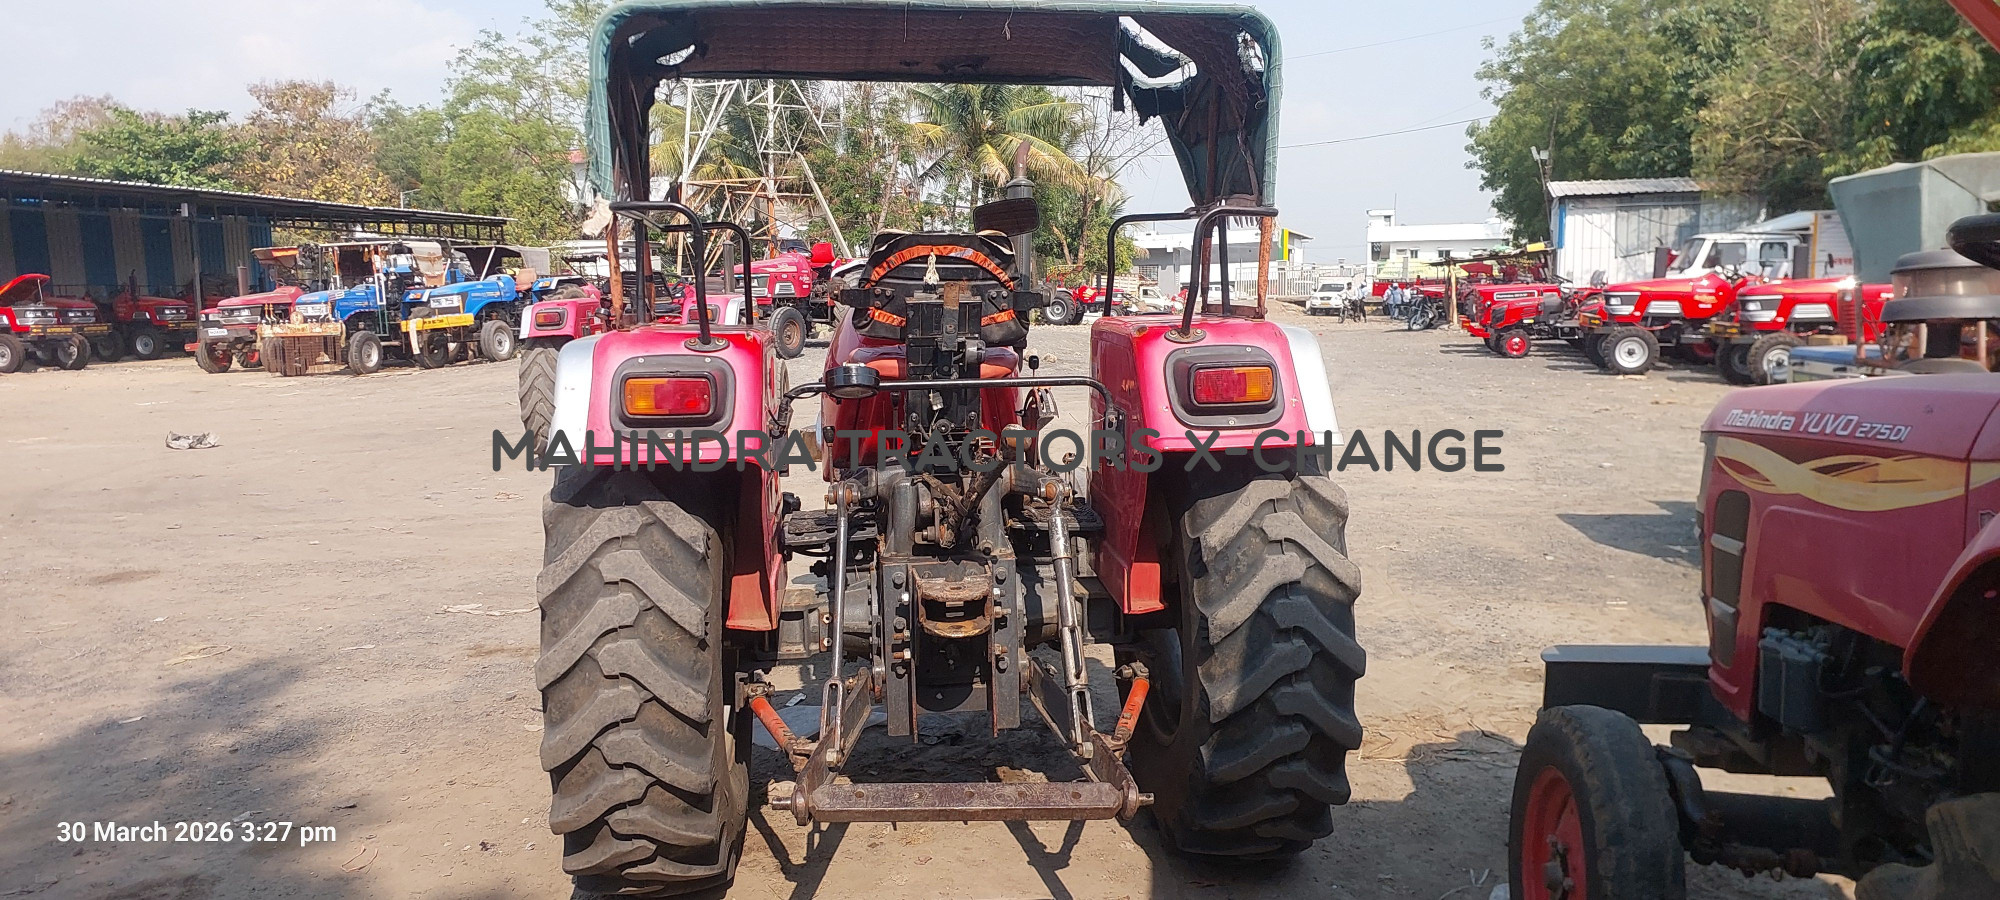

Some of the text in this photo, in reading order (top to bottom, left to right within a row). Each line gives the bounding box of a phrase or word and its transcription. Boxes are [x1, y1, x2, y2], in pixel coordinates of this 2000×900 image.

[1723, 409, 1912, 442] Mahindra YUVO 275DI
